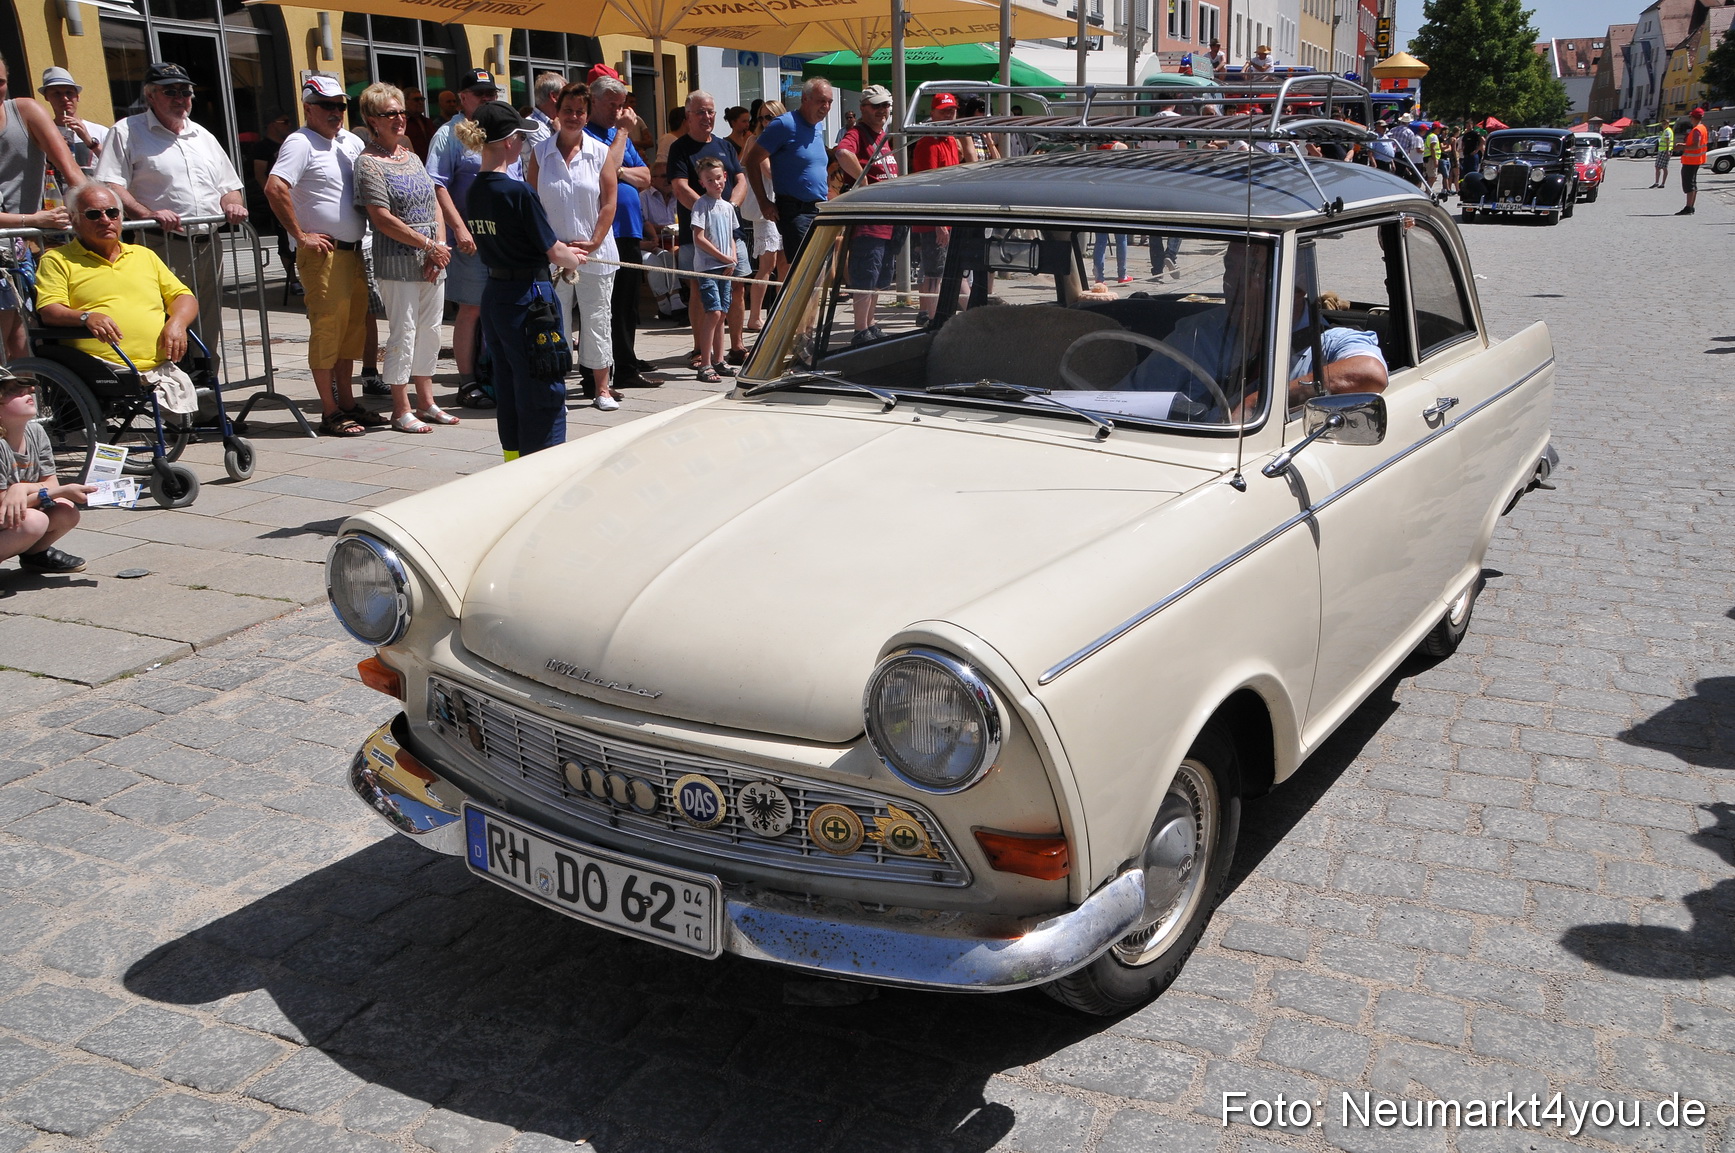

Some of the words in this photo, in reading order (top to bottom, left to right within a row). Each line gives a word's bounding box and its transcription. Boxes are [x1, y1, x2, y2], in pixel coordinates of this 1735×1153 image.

[678, 71, 687, 84] 24
[467, 220, 497, 235] THW
[683, 788, 715, 818] DAS
[487, 822, 532, 885] RH
[554, 851, 608, 913] DO
[620, 874, 676, 934] 62
[683, 888, 702, 906] 04
